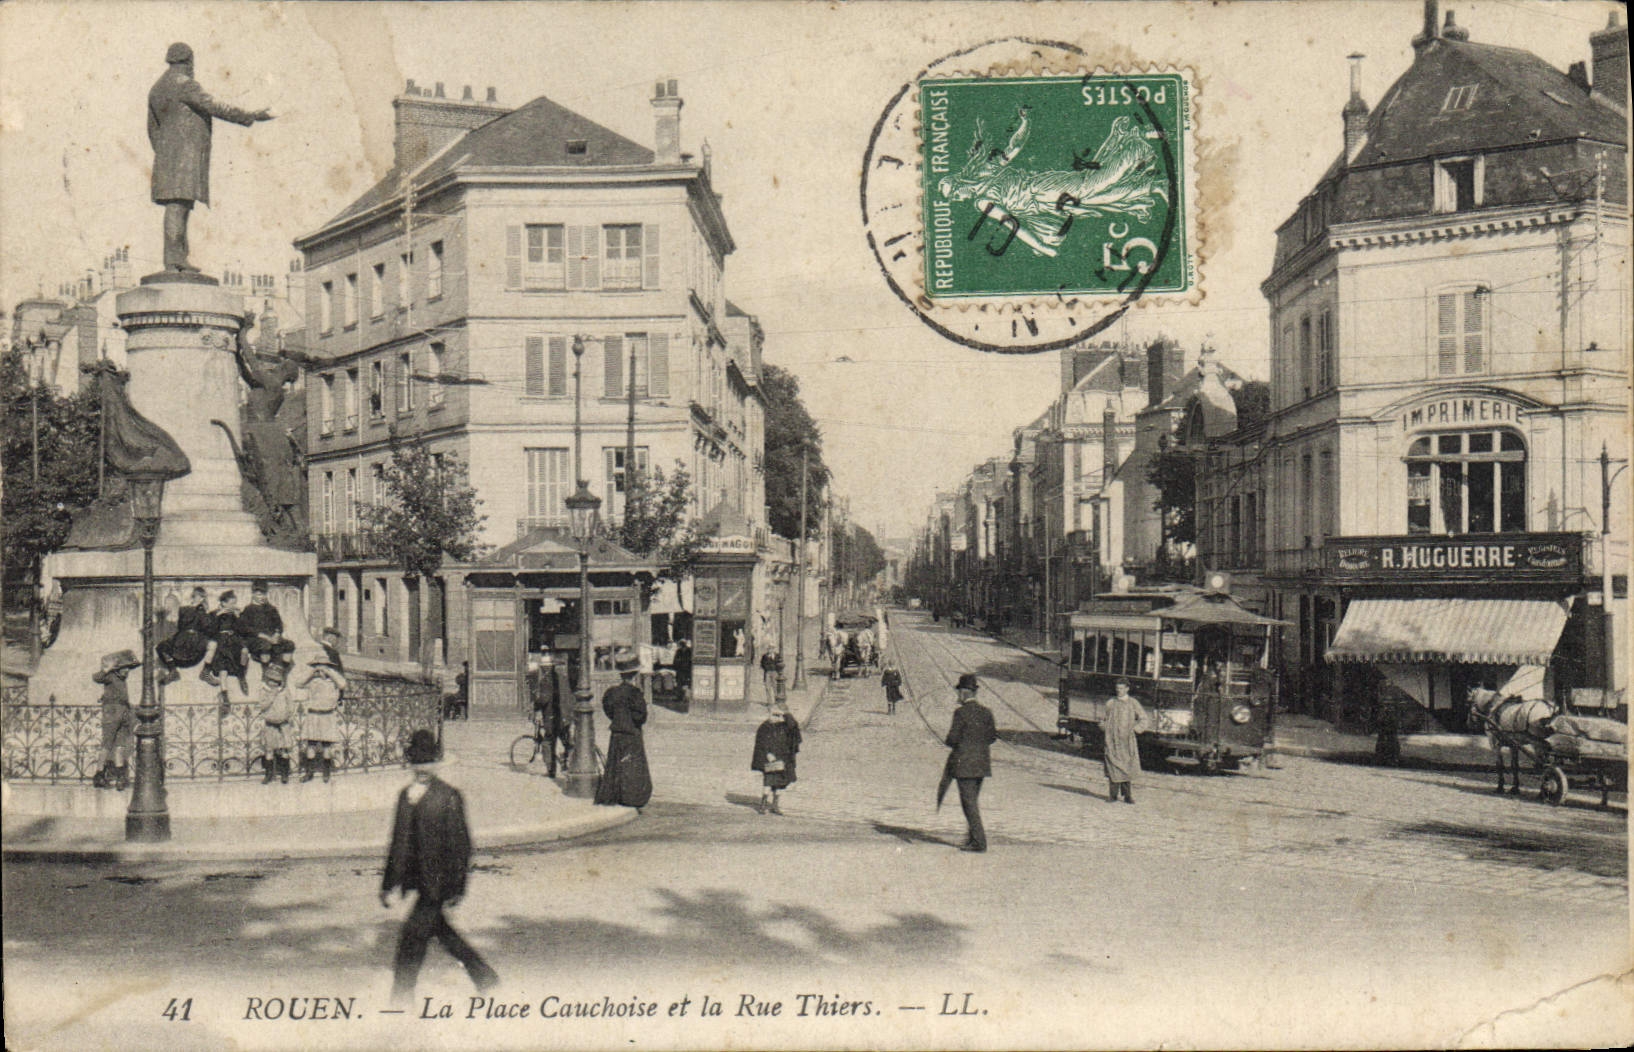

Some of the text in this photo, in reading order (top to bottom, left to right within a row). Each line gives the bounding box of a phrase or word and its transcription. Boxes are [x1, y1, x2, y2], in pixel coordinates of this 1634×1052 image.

[1082, 85, 1167, 105] POSTES
[931, 89, 953, 290] REPUBLIQUE FRANÇAISE
[1402, 399, 1523, 432] IMPRIMERIE
